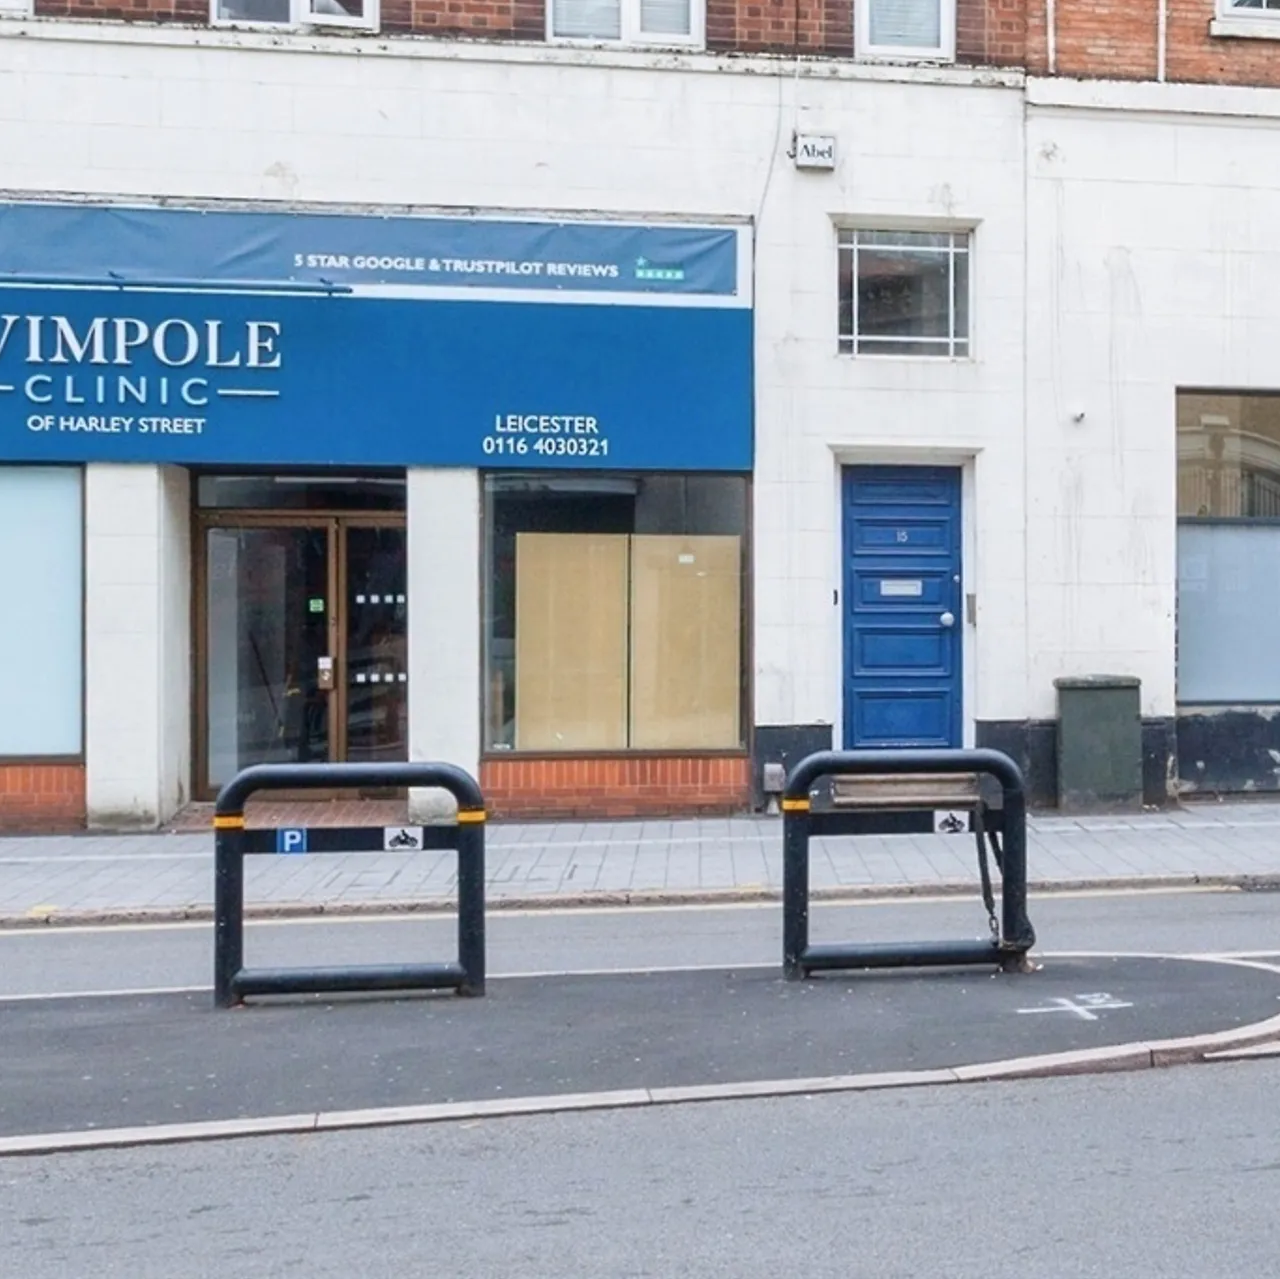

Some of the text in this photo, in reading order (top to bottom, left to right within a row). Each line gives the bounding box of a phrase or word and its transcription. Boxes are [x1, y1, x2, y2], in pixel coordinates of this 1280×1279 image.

[799, 143, 833, 160] Abel
[293, 254, 619, 279] 5 STAR GOOGLE & TRUSTPILOT REVIEWS
[24, 373, 209, 406] CLINIC
[27, 414, 207, 434] OF HARLEY STREET
[494, 414, 600, 434] LEICESTER
[482, 435, 609, 456] 0116 4030321
[283, 830, 302, 852] P
